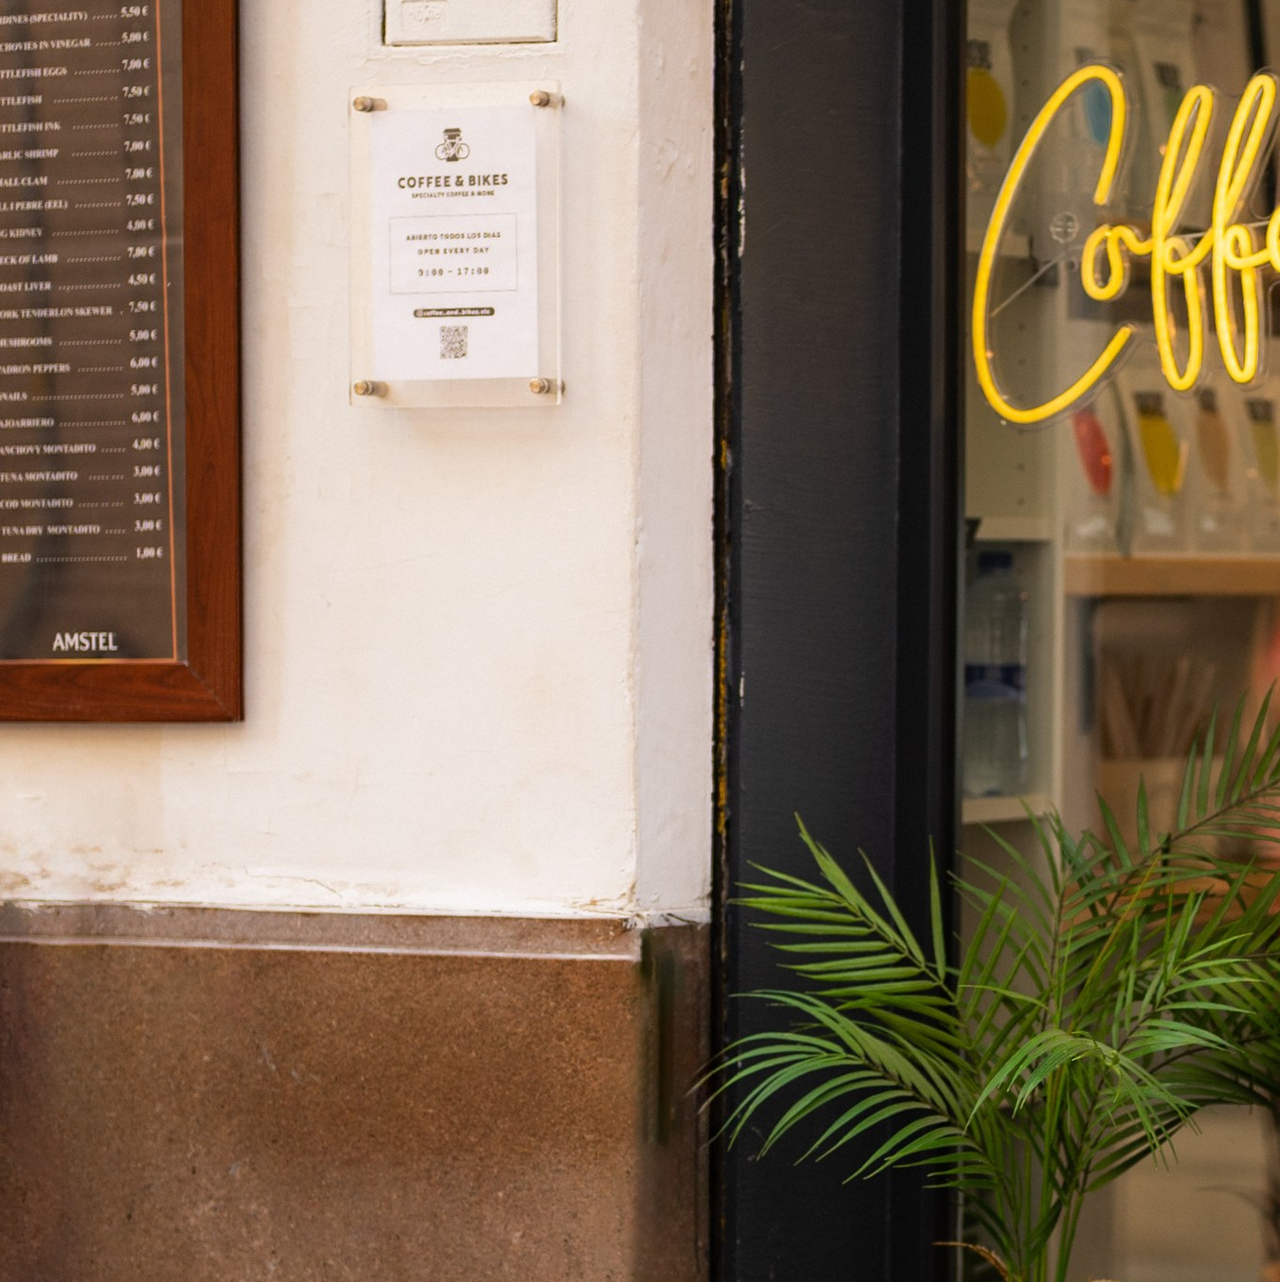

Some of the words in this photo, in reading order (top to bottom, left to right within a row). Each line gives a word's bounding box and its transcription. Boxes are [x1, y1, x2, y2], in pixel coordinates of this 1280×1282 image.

[50, 38, 91, 49] VINEGAR
[44, 121, 62, 131] INK
[24, 149, 60, 160] SHRIMP
[22, 175, 48, 187] CLAM
[398, 175, 451, 189] COFFEE
[455, 175, 464, 188] &
[468, 174, 509, 187] BIKES
[15, 199, 43, 211] PEBRE
[10, 227, 43, 239] KIDNEY
[406, 233, 438, 241] ABIERTO
[473, 246, 489, 254] DAY
[18, 255, 31, 265] OF
[32, 253, 58, 265] LAMB
[24, 281, 52, 291] LIVER
[74, 305, 112, 317] SKEWER
[32, 363, 72, 373] PEPPERS
[0, 445, 42, 457] ANCHOVY
[42, 443, 97, 455] MONTADITO
[0, 471, 24, 483] TUNA
[25, 471, 78, 482] MONTADITO
[0, 499, 19, 509] COD
[20, 498, 74, 509] MONTADITO
[1, 525, 25, 536] TUNA
[26, 525, 44, 535] DRY
[46, 524, 100, 535] MONTADITO
[1, 553, 32, 563] BREAD
[52, 631, 118, 652] AMSTEL
